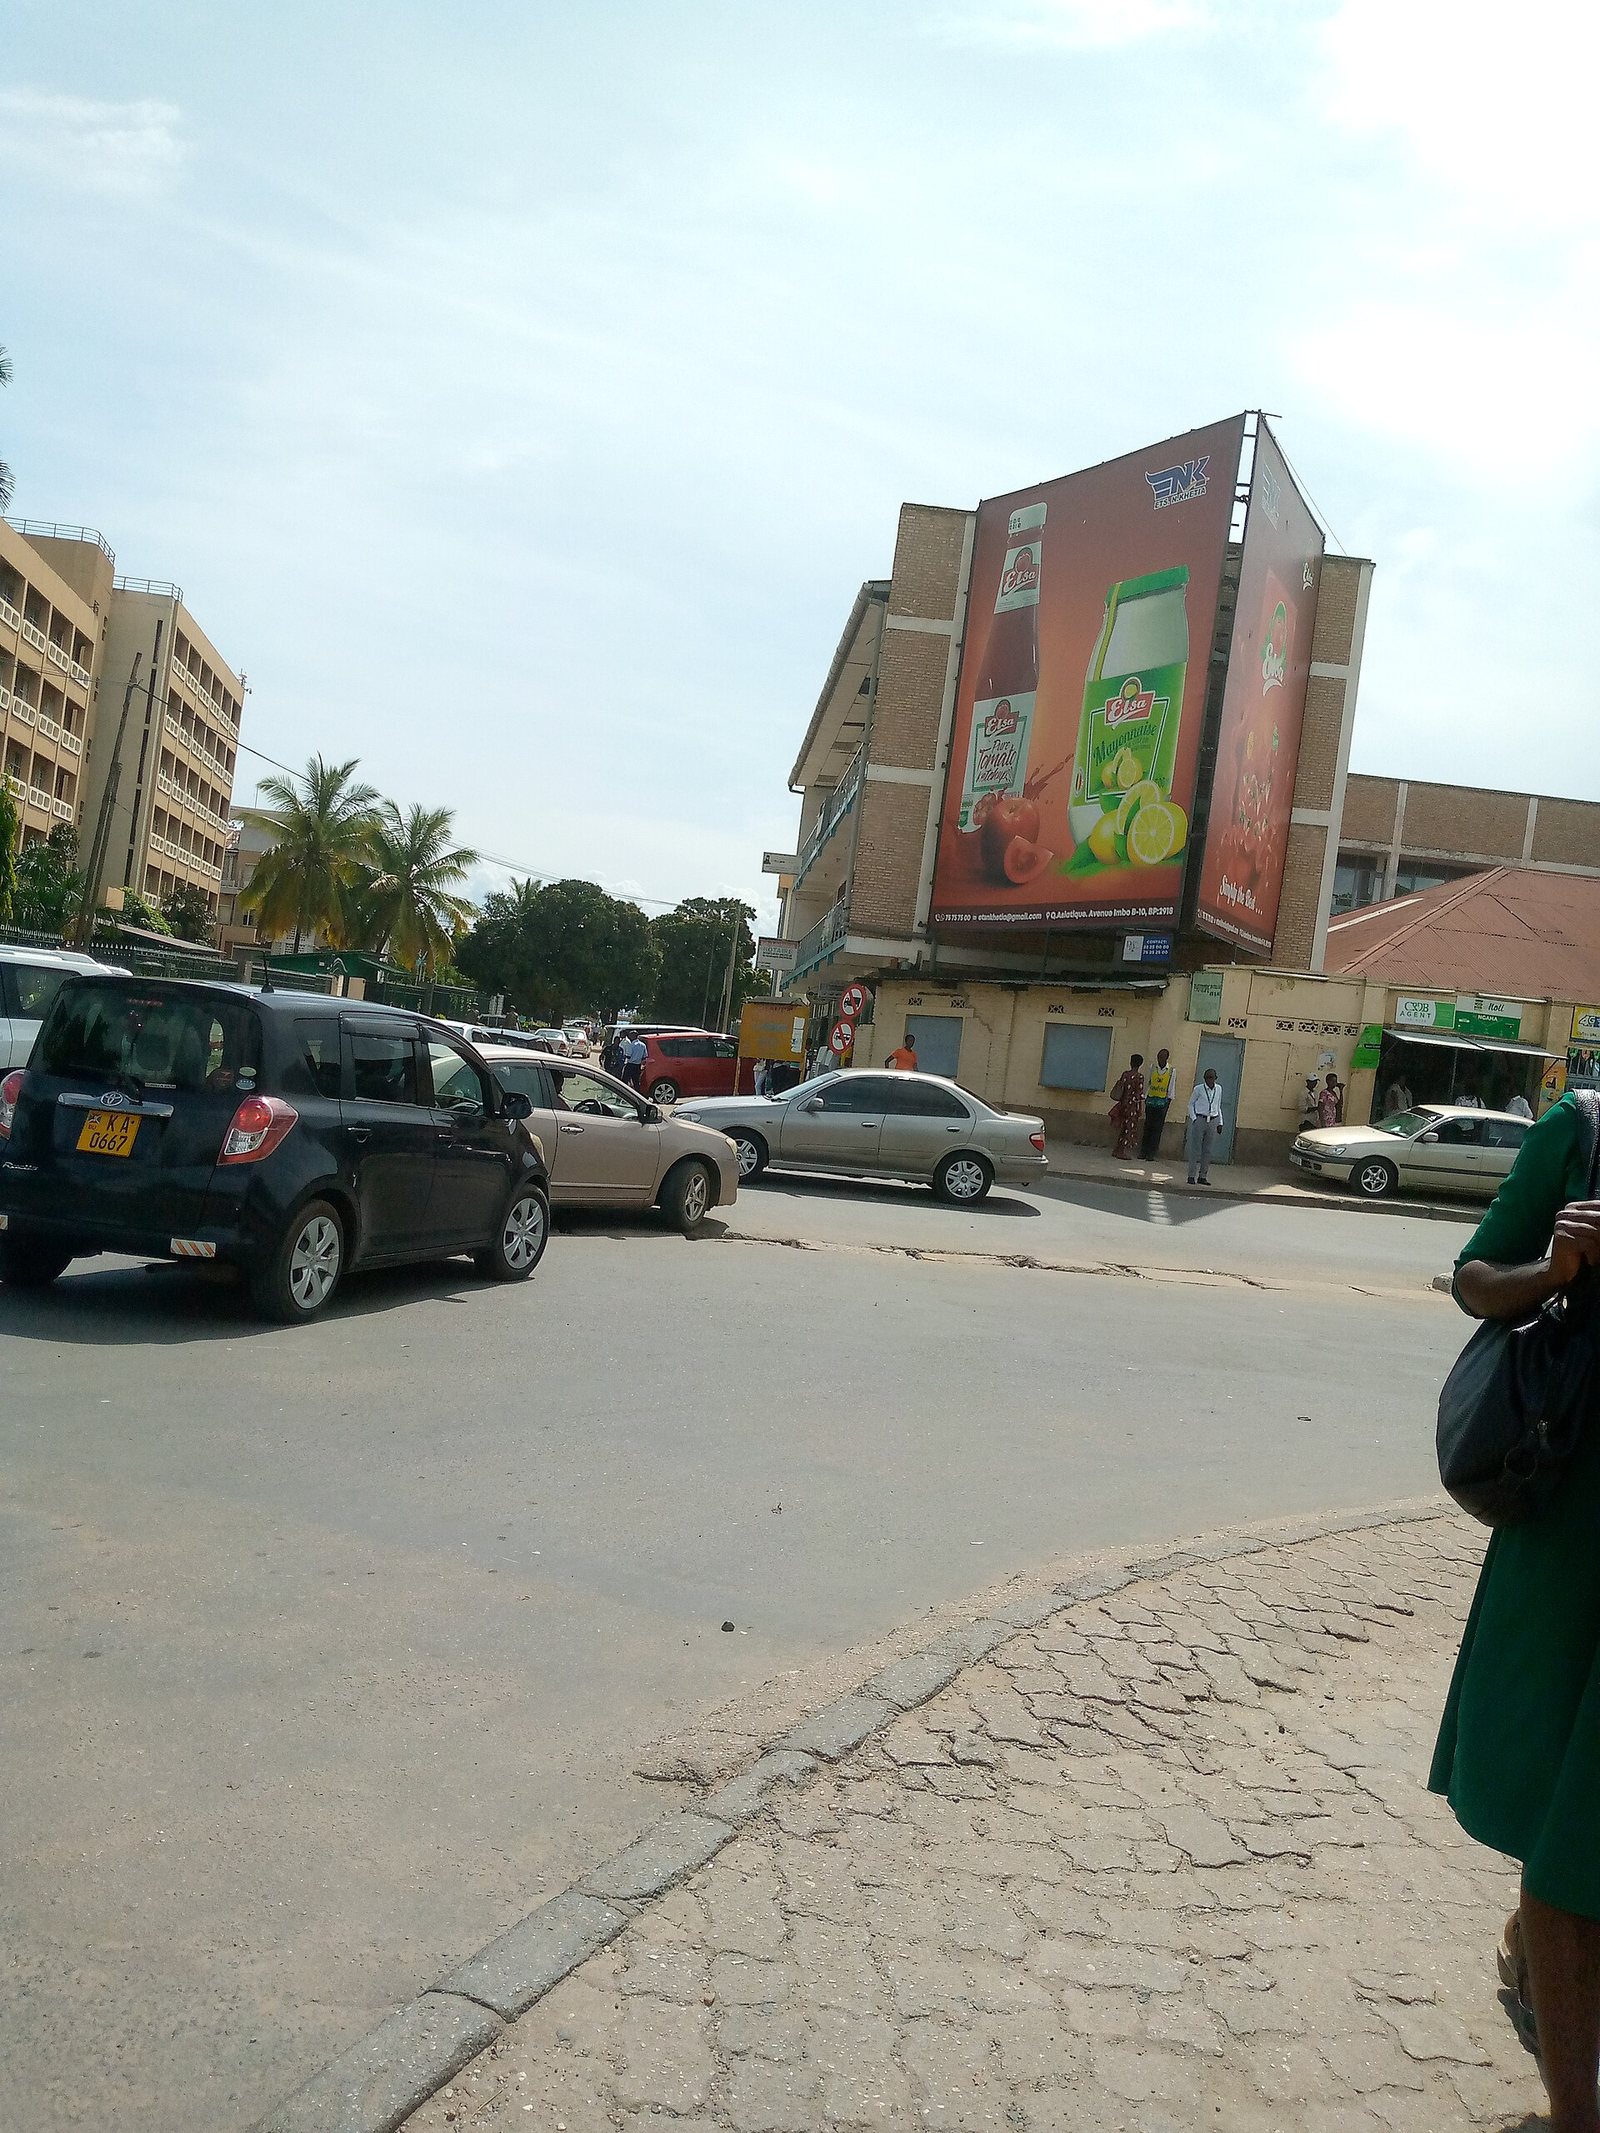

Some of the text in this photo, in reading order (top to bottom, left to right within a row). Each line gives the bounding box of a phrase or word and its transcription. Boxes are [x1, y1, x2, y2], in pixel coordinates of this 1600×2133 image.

[1004, 570, 1036, 593] Elsa
[1107, 699, 1147, 722] Elsa
[986, 718, 1015, 734] Elsa
[1093, 722, 1158, 767] Mayonnaise
[1088, 909, 1113, 918] Avenue
[1113, 908, 1131, 917] Imbo
[1399, 1010, 1431, 1019] AGENT
[1404, 1001, 1430, 1013] CRDB
[89, 1132, 128, 1152] 0667
